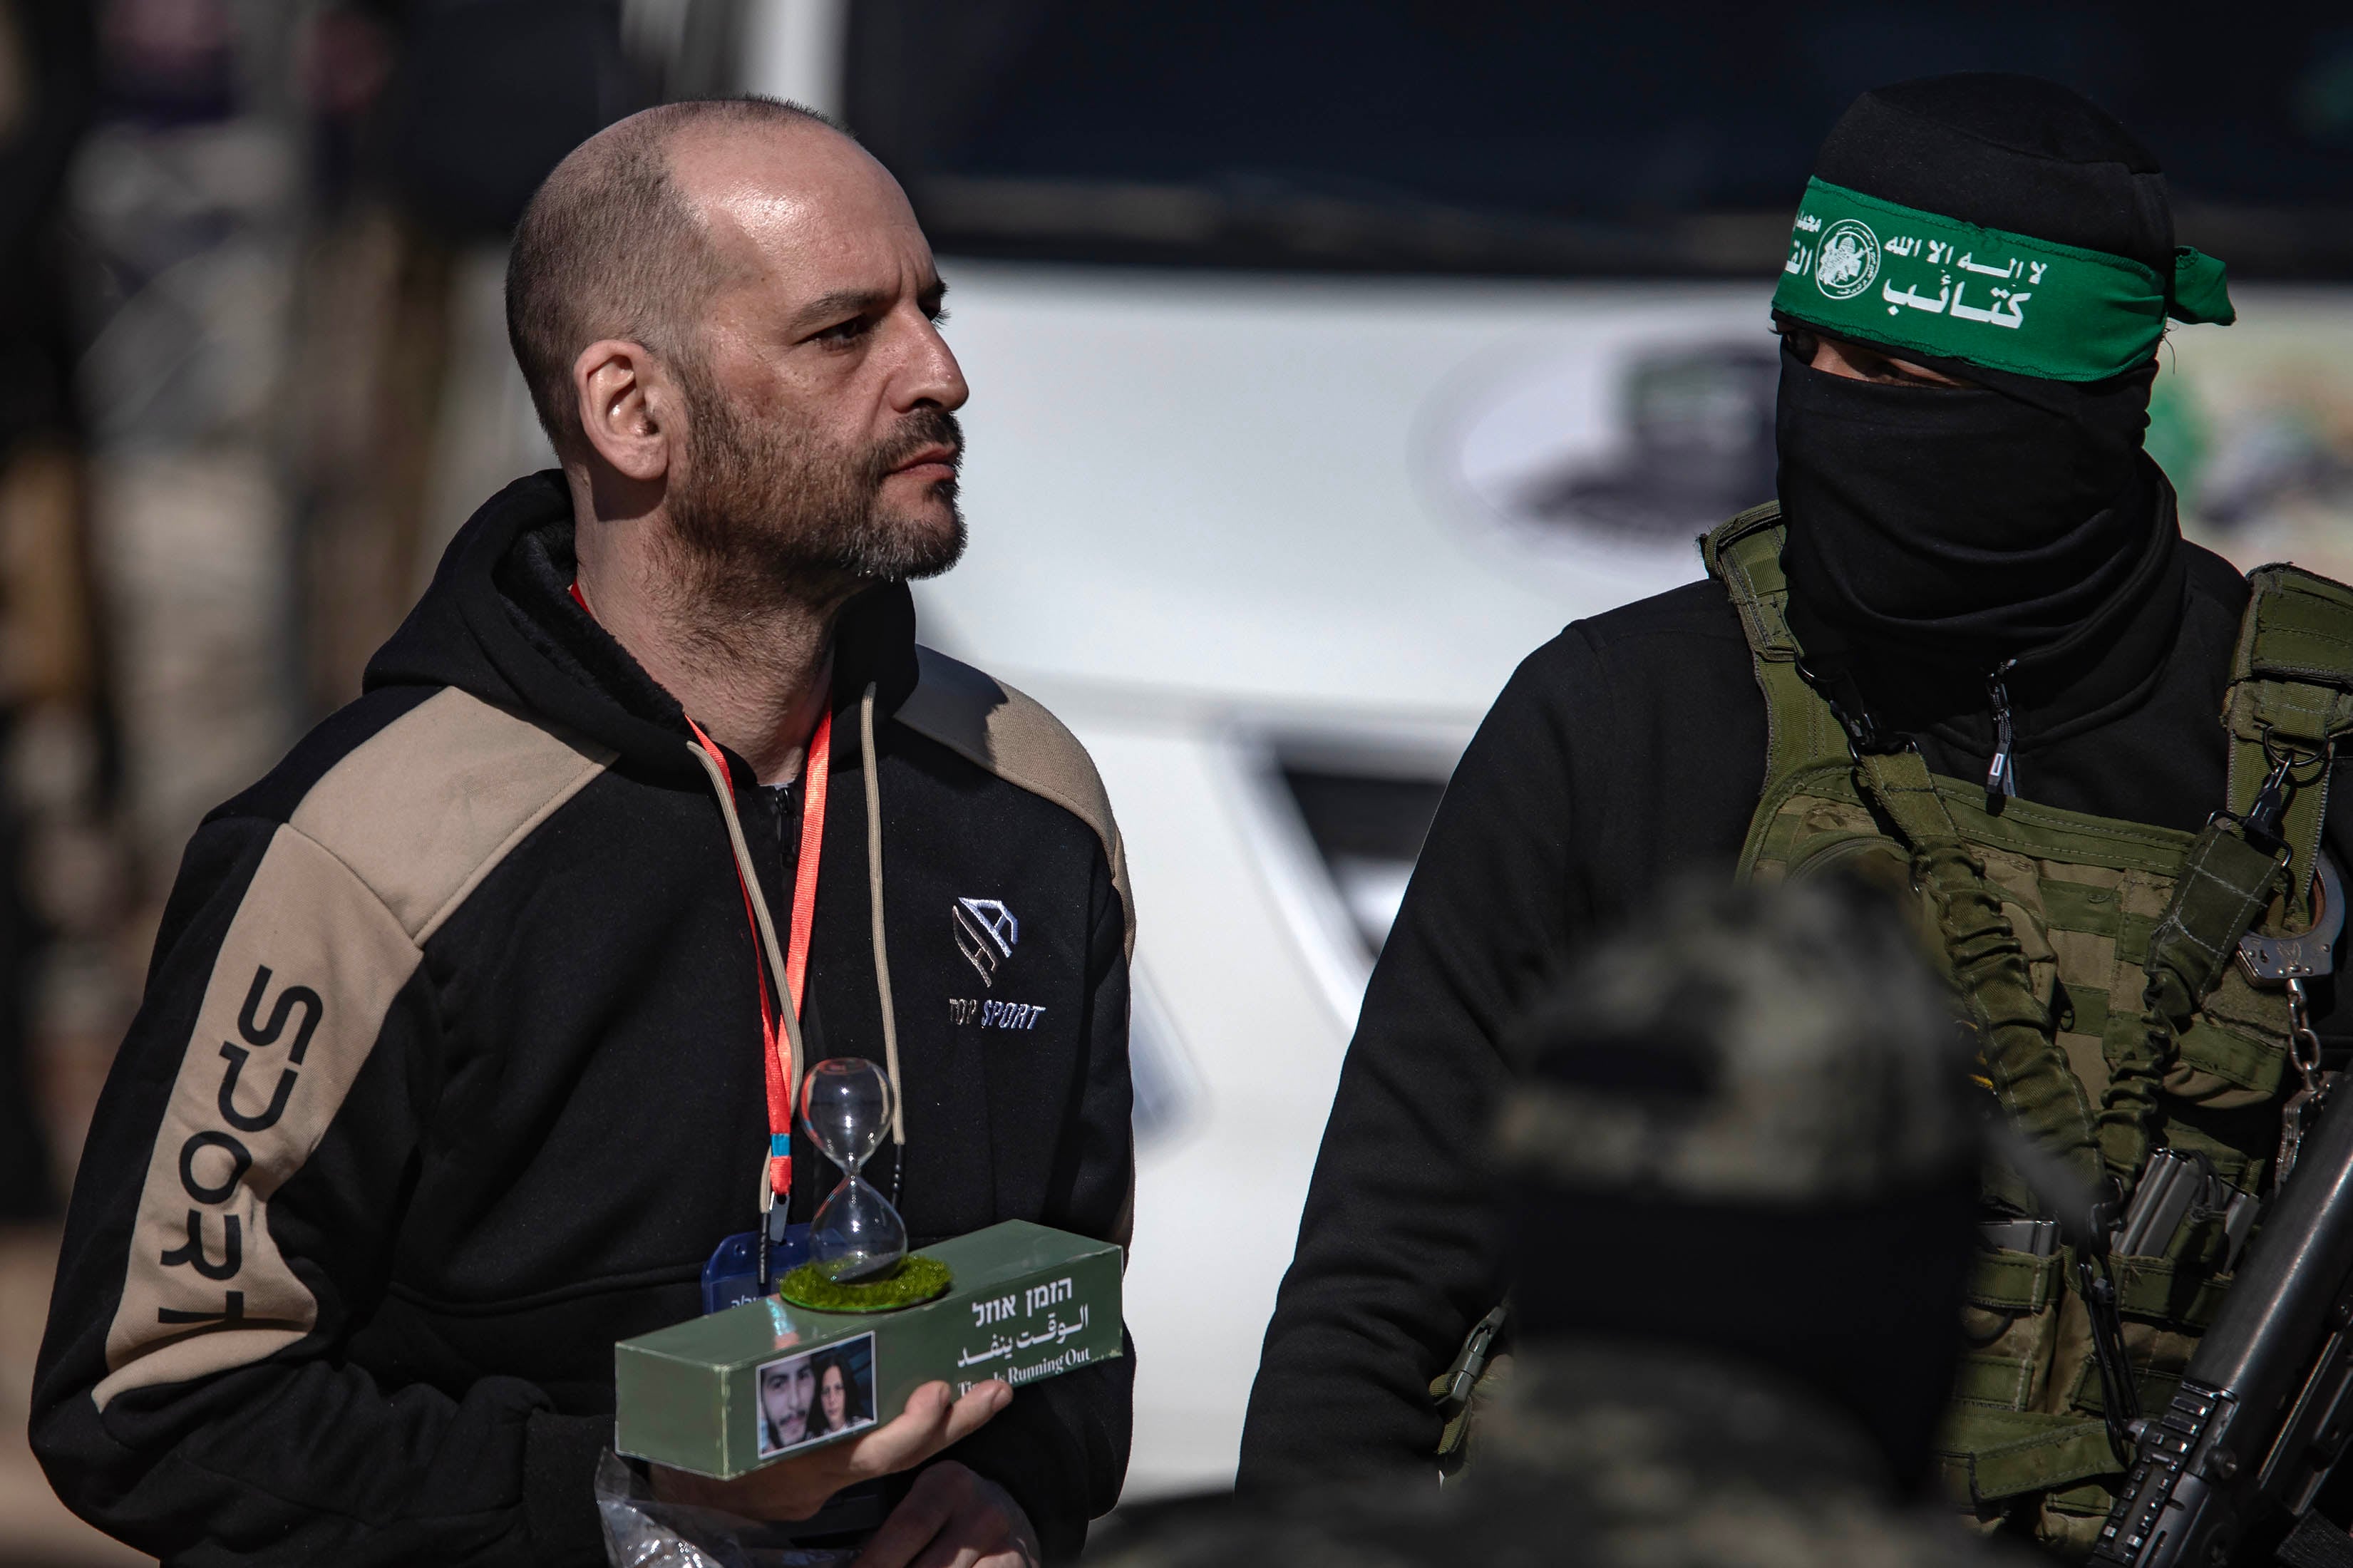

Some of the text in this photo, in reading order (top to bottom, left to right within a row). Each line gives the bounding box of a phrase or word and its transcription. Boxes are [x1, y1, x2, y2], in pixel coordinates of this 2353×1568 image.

[1883, 236, 1922, 257] الله
[2028, 260, 2048, 285] لا
[1882, 274, 2032, 329] كتائب
[949, 998, 1046, 1030] TOP SPORT
[156, 964, 324, 1326] SPORT
[972, 1276, 1073, 1328] הזמן אוזל
[1016, 1303, 1089, 1349] الوقت
[1008, 1355, 1065, 1384] Running
[1064, 1347, 1091, 1366] Out
